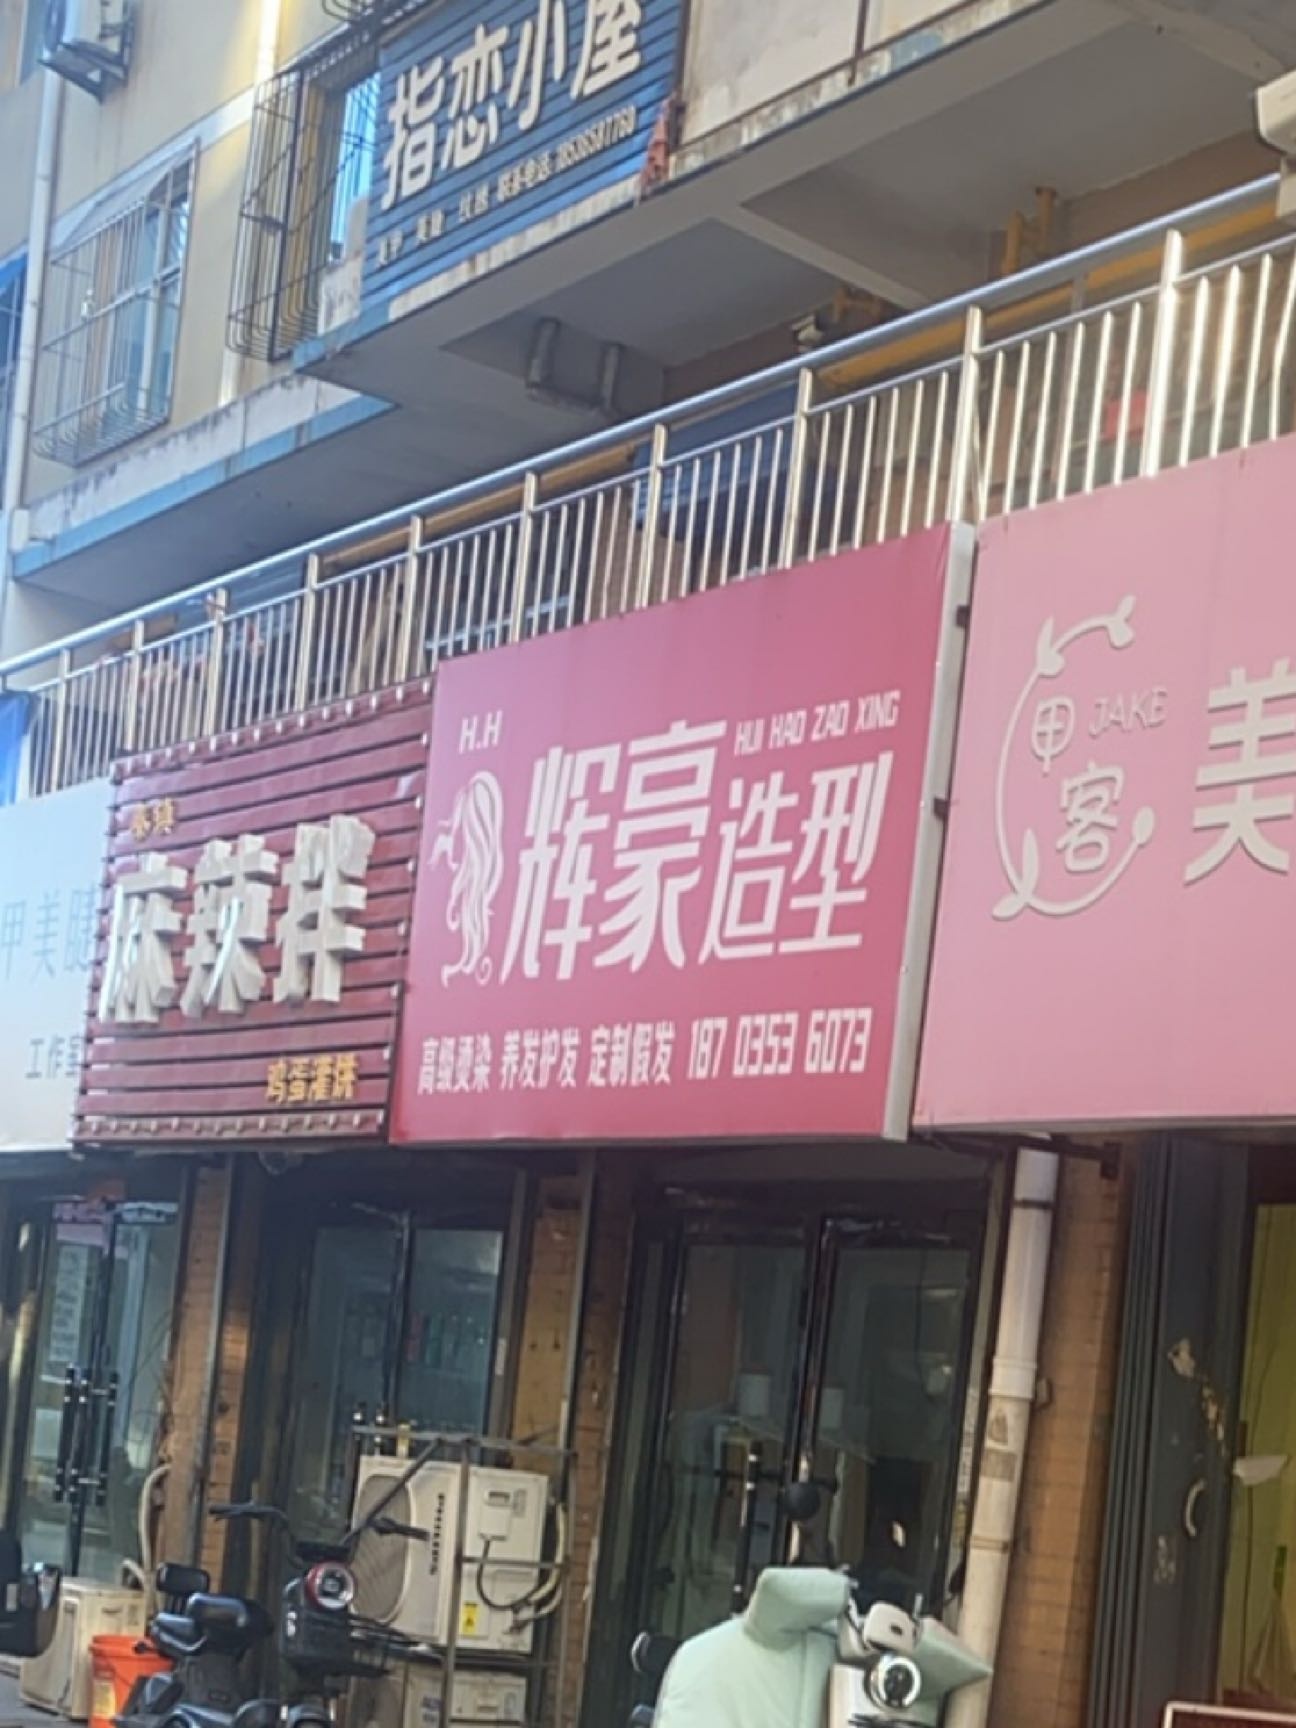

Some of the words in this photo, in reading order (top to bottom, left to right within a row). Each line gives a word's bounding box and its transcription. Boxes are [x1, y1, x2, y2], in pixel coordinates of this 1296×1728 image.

[380, 0, 642, 211] 指恋小屋
[768, 708, 807, 749] HAO
[811, 699, 850, 742] ZAO
[854, 689, 901, 734] XING
[1088, 684, 1168, 738] JAKE
[501, 719, 894, 986] 辉豪造型
[687, 1015, 728, 1080] 187
[732, 1011, 799, 1078] 0353
[804, 1006, 873, 1074] 6073
